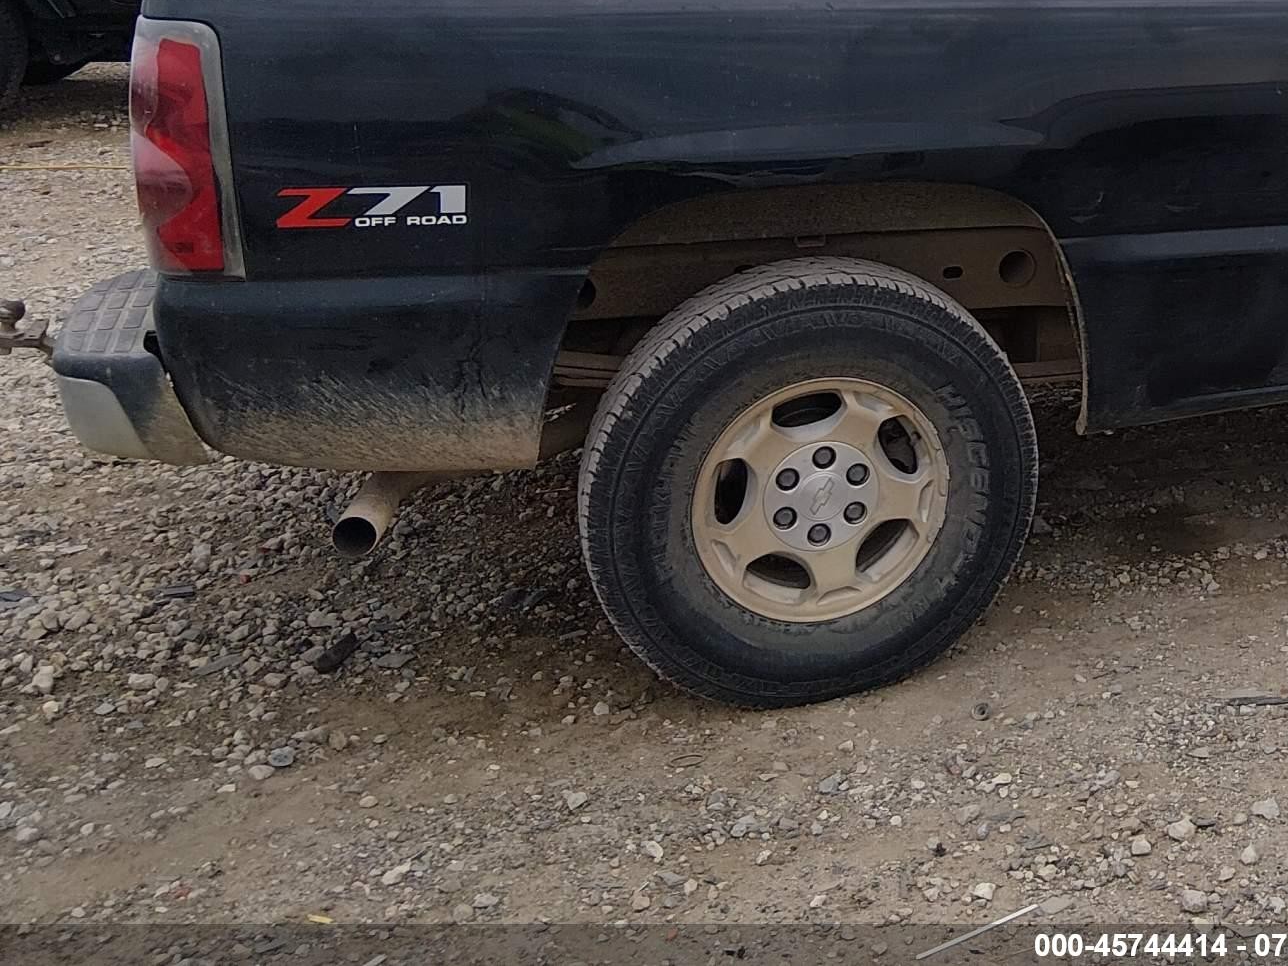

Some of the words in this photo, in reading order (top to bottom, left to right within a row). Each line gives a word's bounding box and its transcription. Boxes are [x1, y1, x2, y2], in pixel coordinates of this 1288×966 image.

[275, 185, 467, 229] Z71
[354, 216, 397, 227] OFF
[406, 214, 468, 226] ROAD
